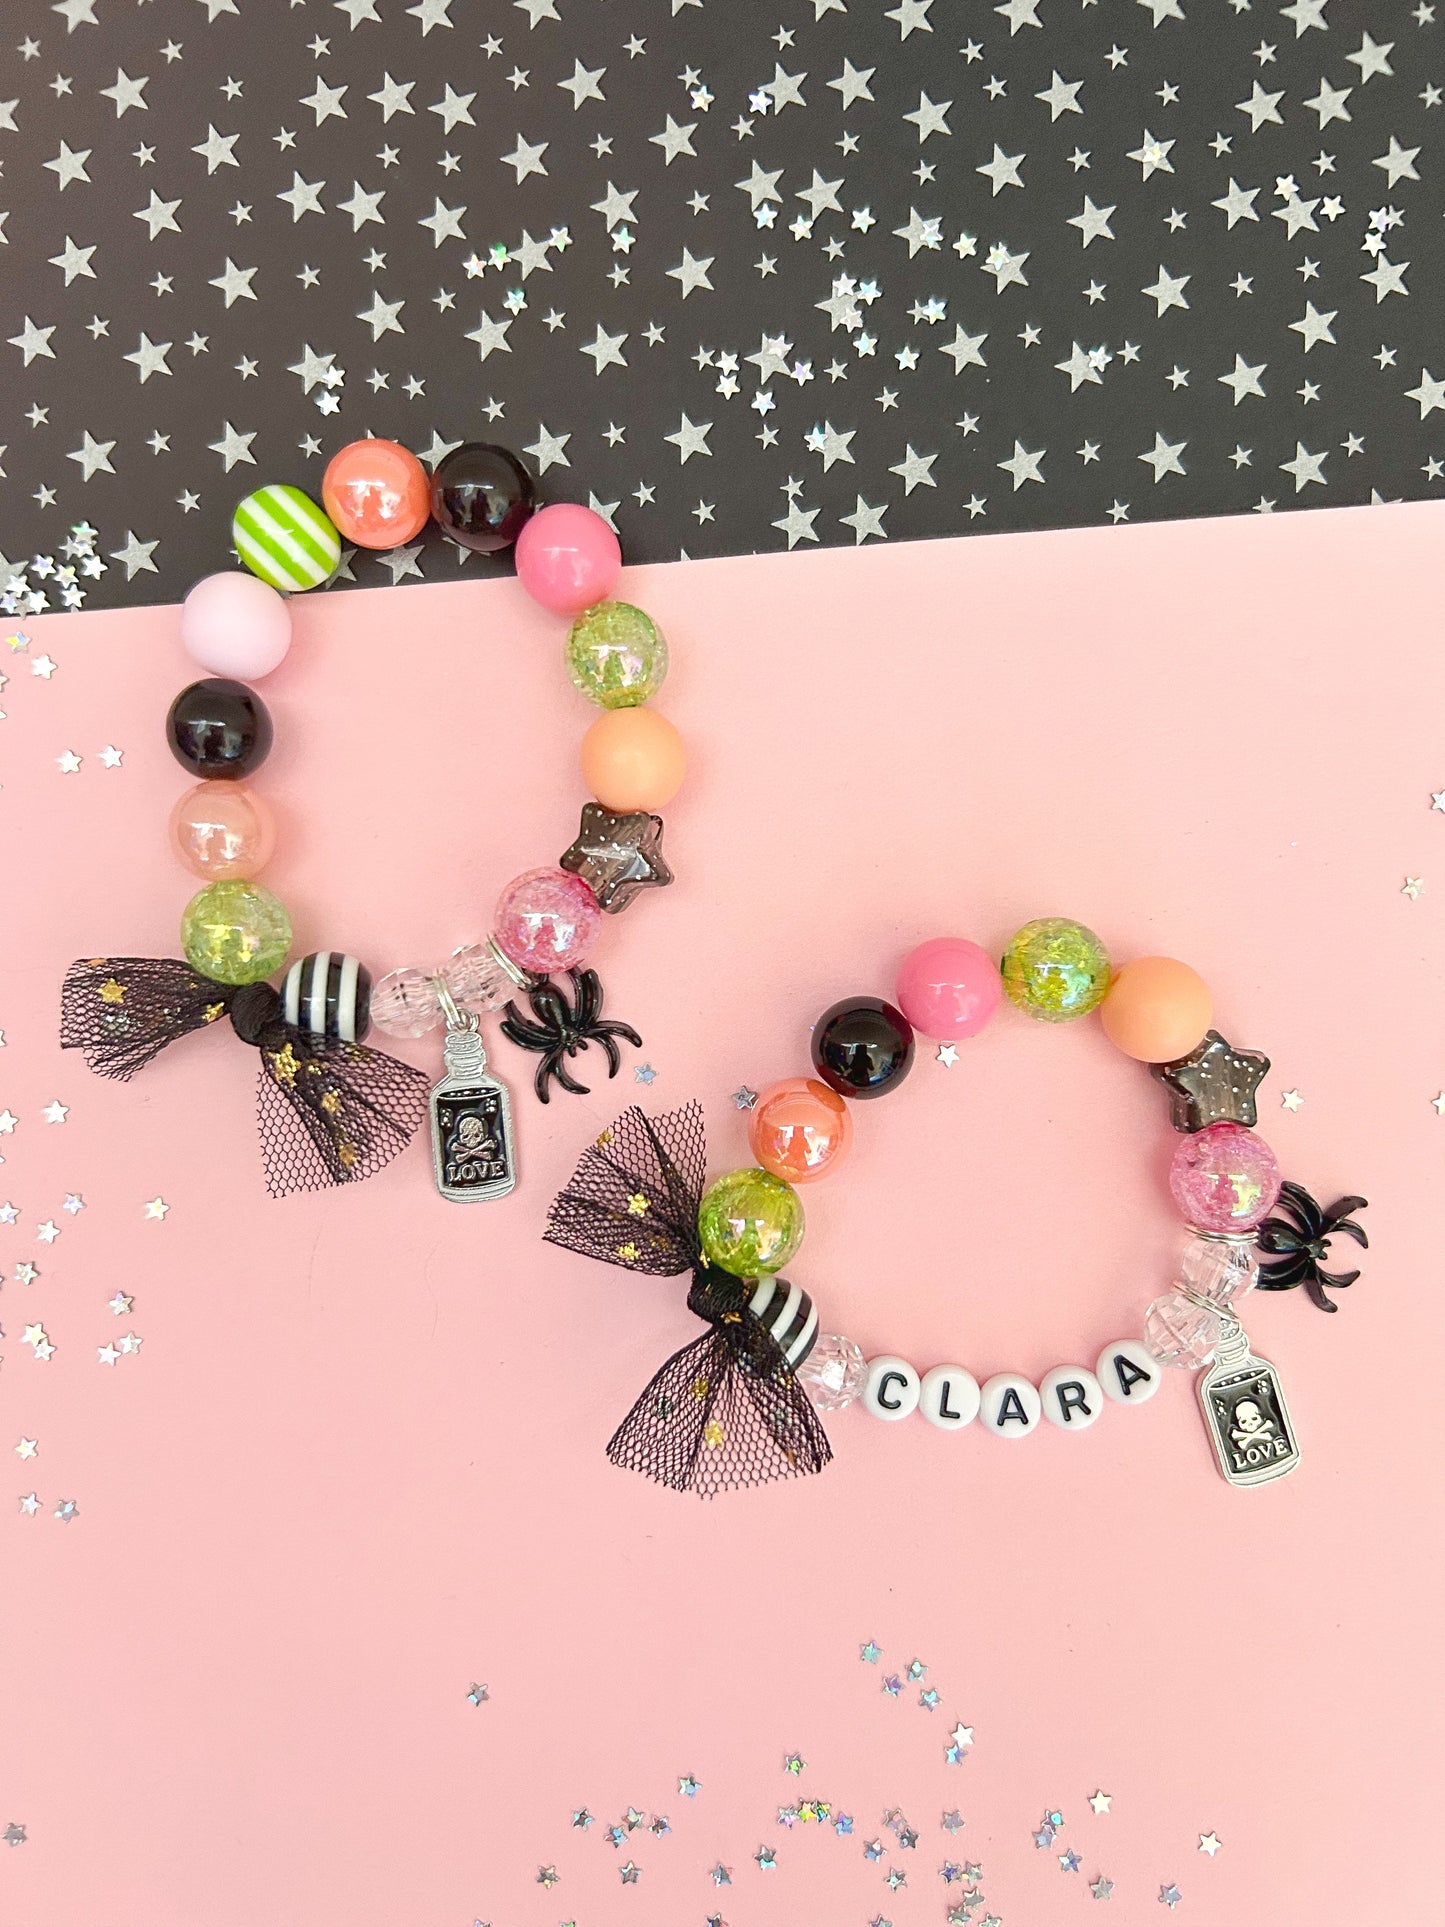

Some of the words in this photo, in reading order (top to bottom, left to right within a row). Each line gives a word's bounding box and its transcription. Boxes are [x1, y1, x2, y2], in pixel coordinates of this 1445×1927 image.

[448, 1161, 505, 1182] LOVE
[877, 1354, 1152, 1427] CLARA
[1232, 1438, 1288, 1469] LOVE
